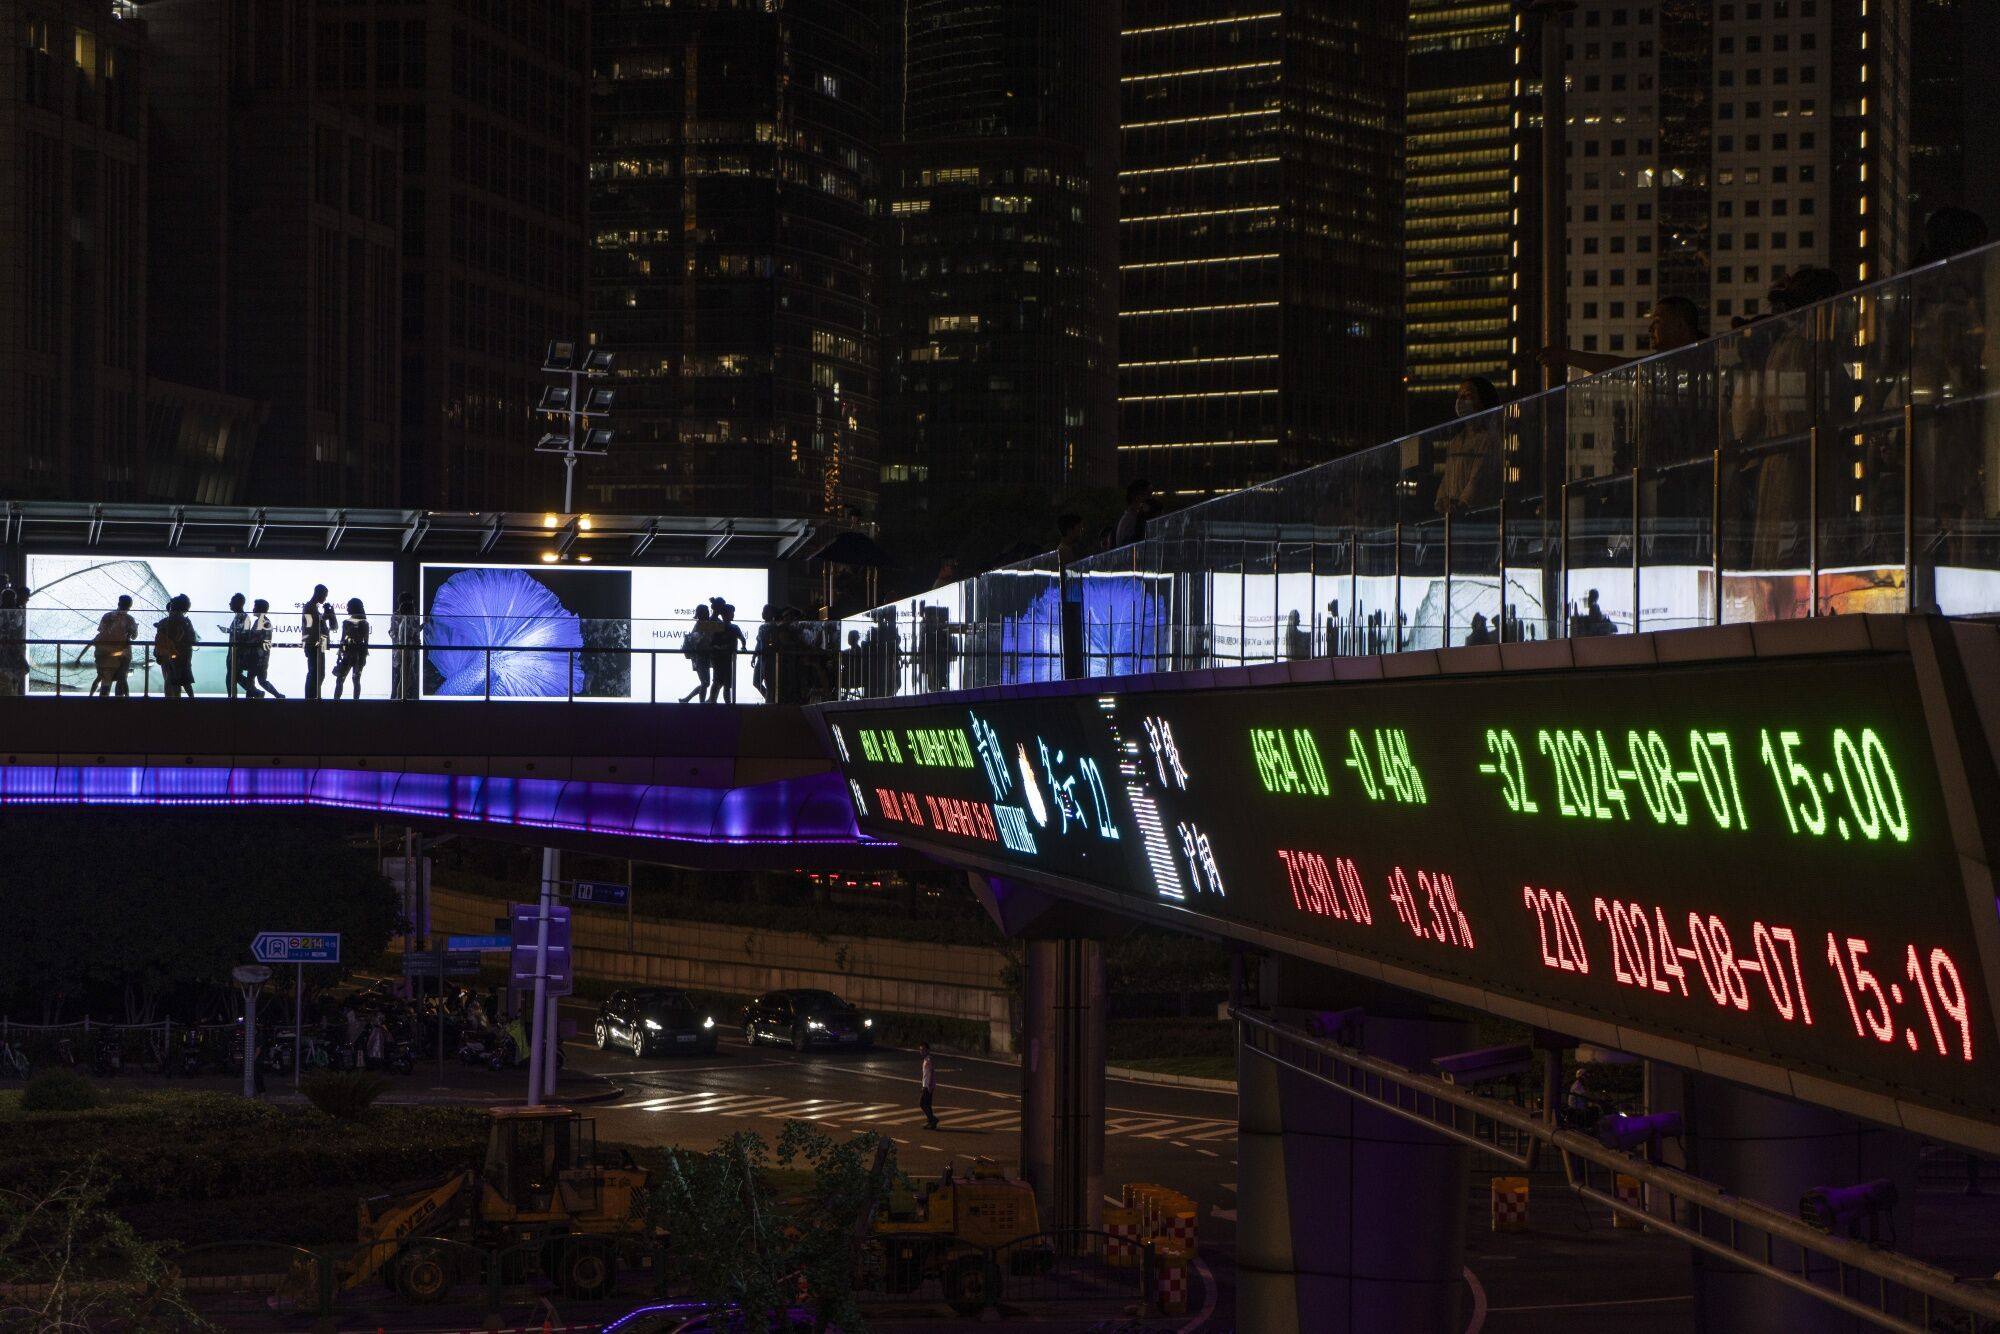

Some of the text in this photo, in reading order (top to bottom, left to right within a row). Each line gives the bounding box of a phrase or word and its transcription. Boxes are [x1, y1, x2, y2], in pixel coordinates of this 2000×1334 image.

[272, 625, 302, 633] HUAW
[1251, 729, 1329, 796] 6954.00
[1346, 729, 1427, 804] -0.46%
[1480, 729, 1539, 813] -32
[1540, 729, 1748, 831] 2024-08-07
[1761, 728, 1910, 843] 15:00
[1279, 850, 1371, 925] 71390.00
[1388, 867, 1474, 949] +0.31%
[1523, 886, 1589, 974] 220
[1594, 897, 1813, 1025] 2024-08-07
[1827, 932, 1973, 1061] 15:19
